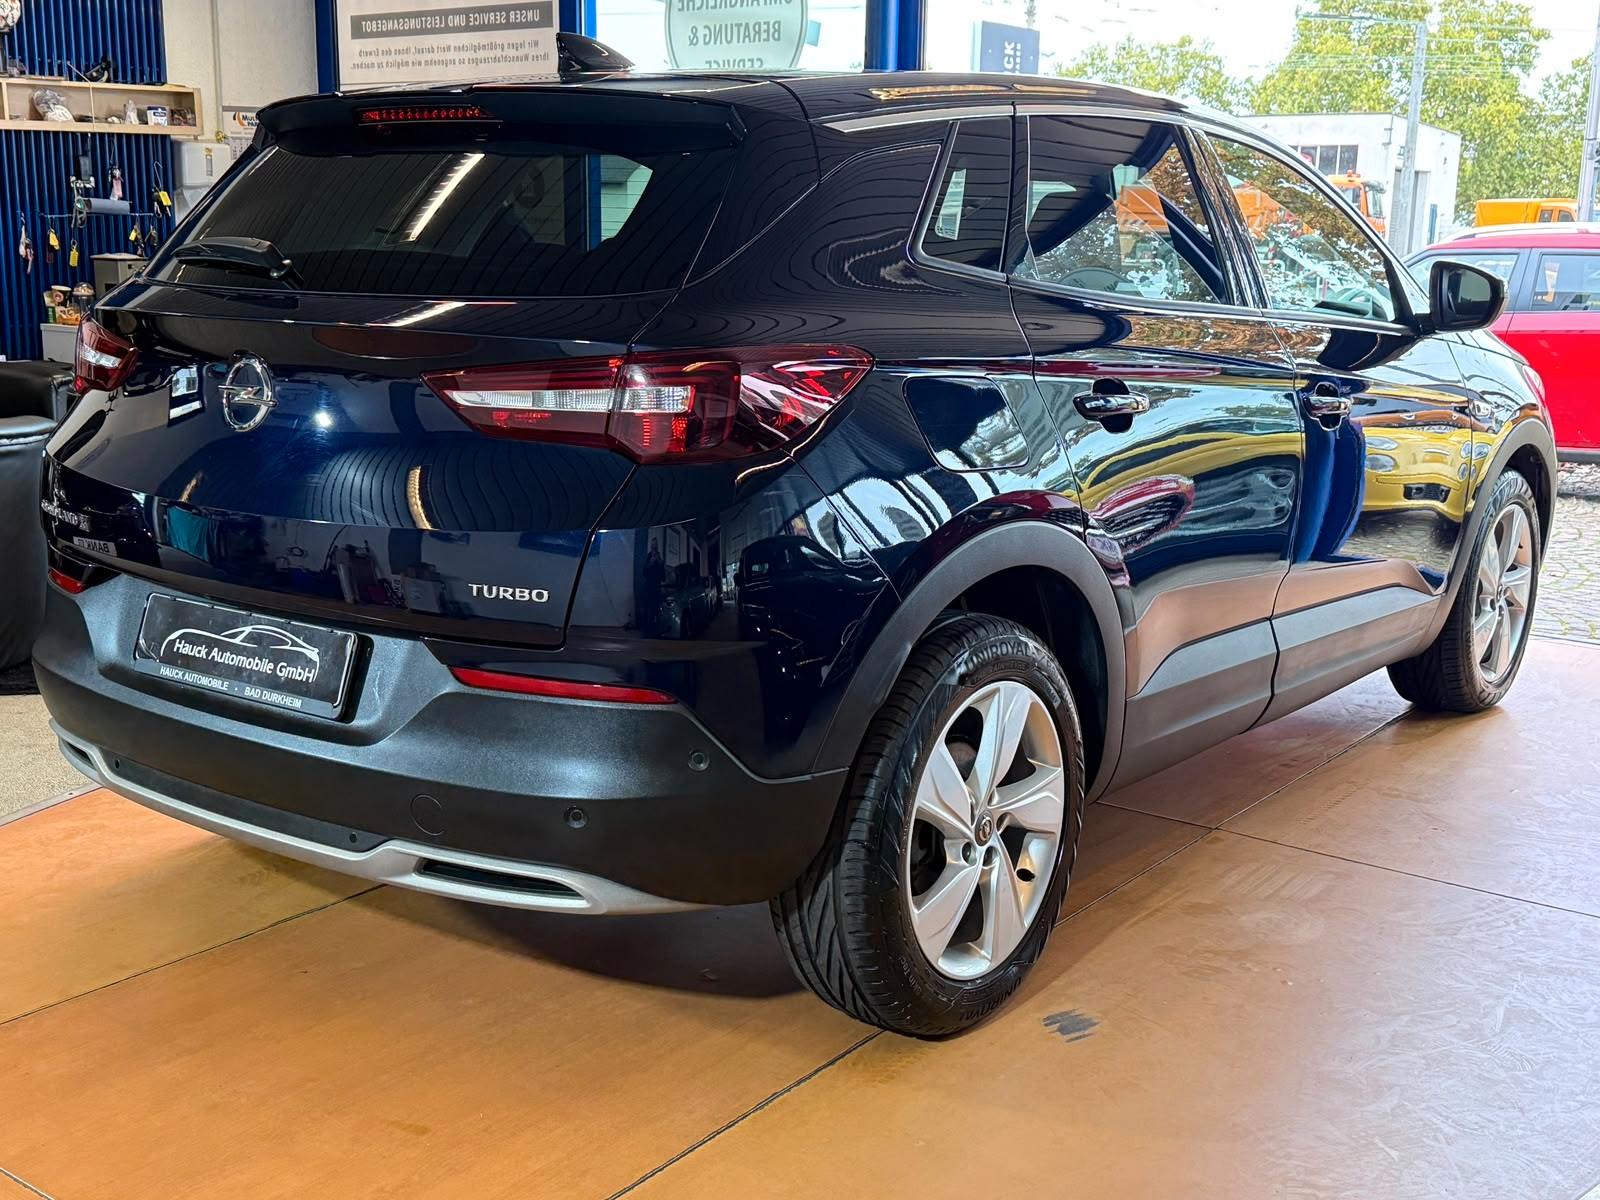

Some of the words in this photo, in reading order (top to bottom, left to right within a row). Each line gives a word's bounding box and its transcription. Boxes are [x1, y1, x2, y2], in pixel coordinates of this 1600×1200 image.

[468, 583, 549, 603] TURBO
[174, 638, 207, 659] Hauck
[208, 647, 274, 675] Automobile
[276, 661, 315, 684] GmbH
[963, 640, 1033, 672] UNIROYAL
[159, 665, 183, 681] HAUCK
[184, 672, 230, 691] AUTOMOBILE
[244, 686, 262, 699] BAD
[262, 690, 303, 709] DURKHEIM
